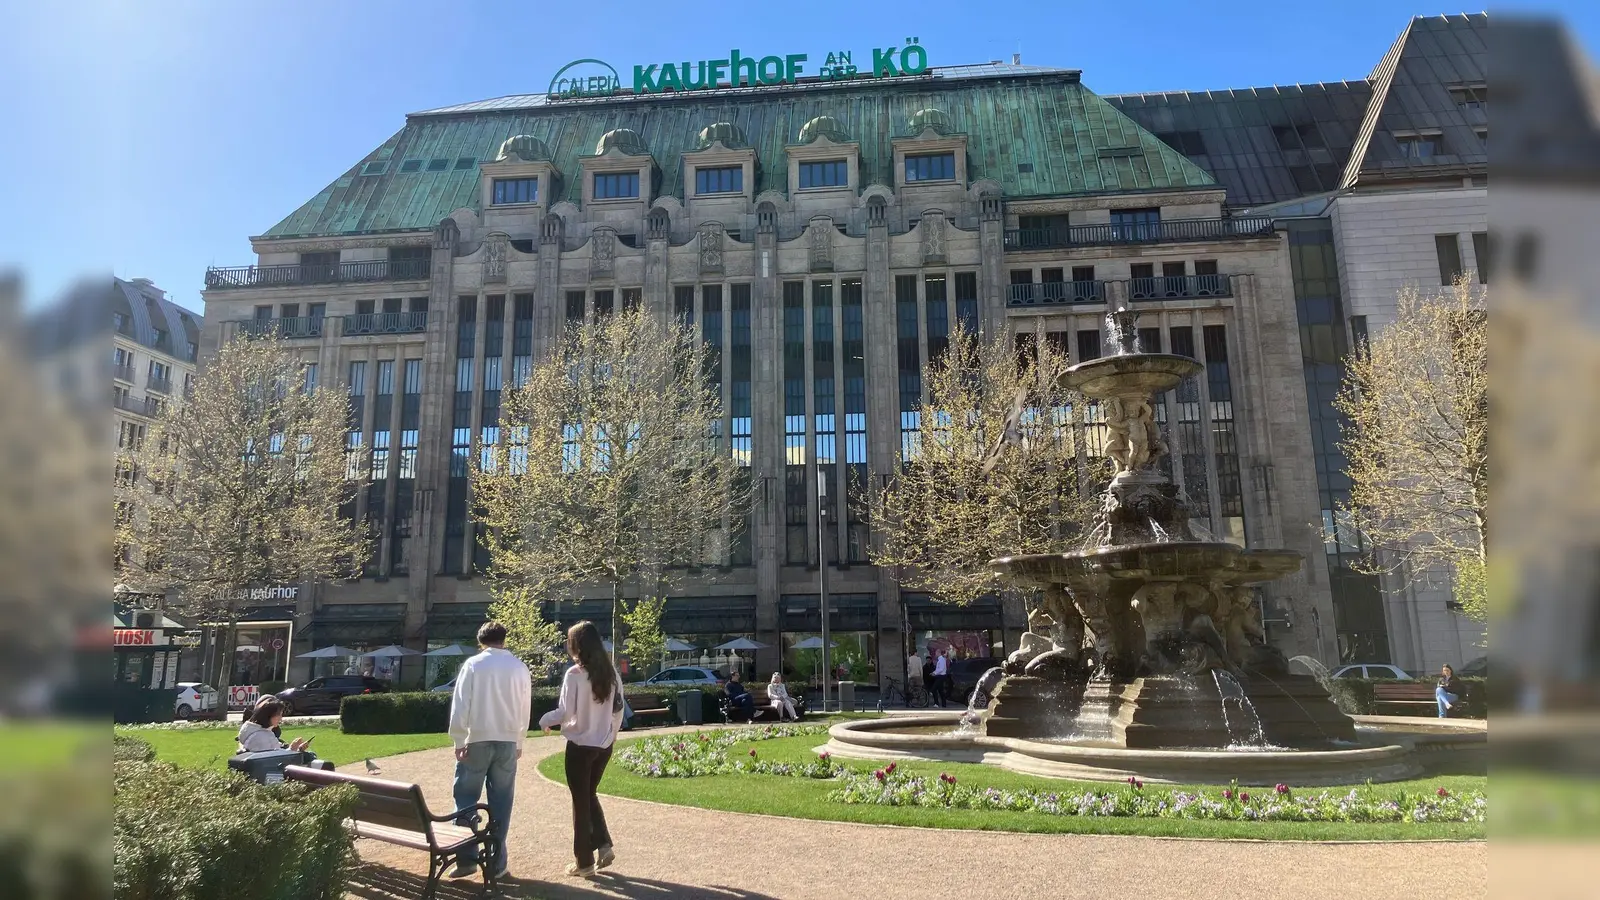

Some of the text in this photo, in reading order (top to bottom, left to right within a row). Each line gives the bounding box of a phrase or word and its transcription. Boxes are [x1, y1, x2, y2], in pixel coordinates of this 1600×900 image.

[824, 50, 852, 66] AN
[873, 36, 928, 78] KÖ
[820, 65, 858, 81] DER
[558, 75, 620, 99] GALERIA
